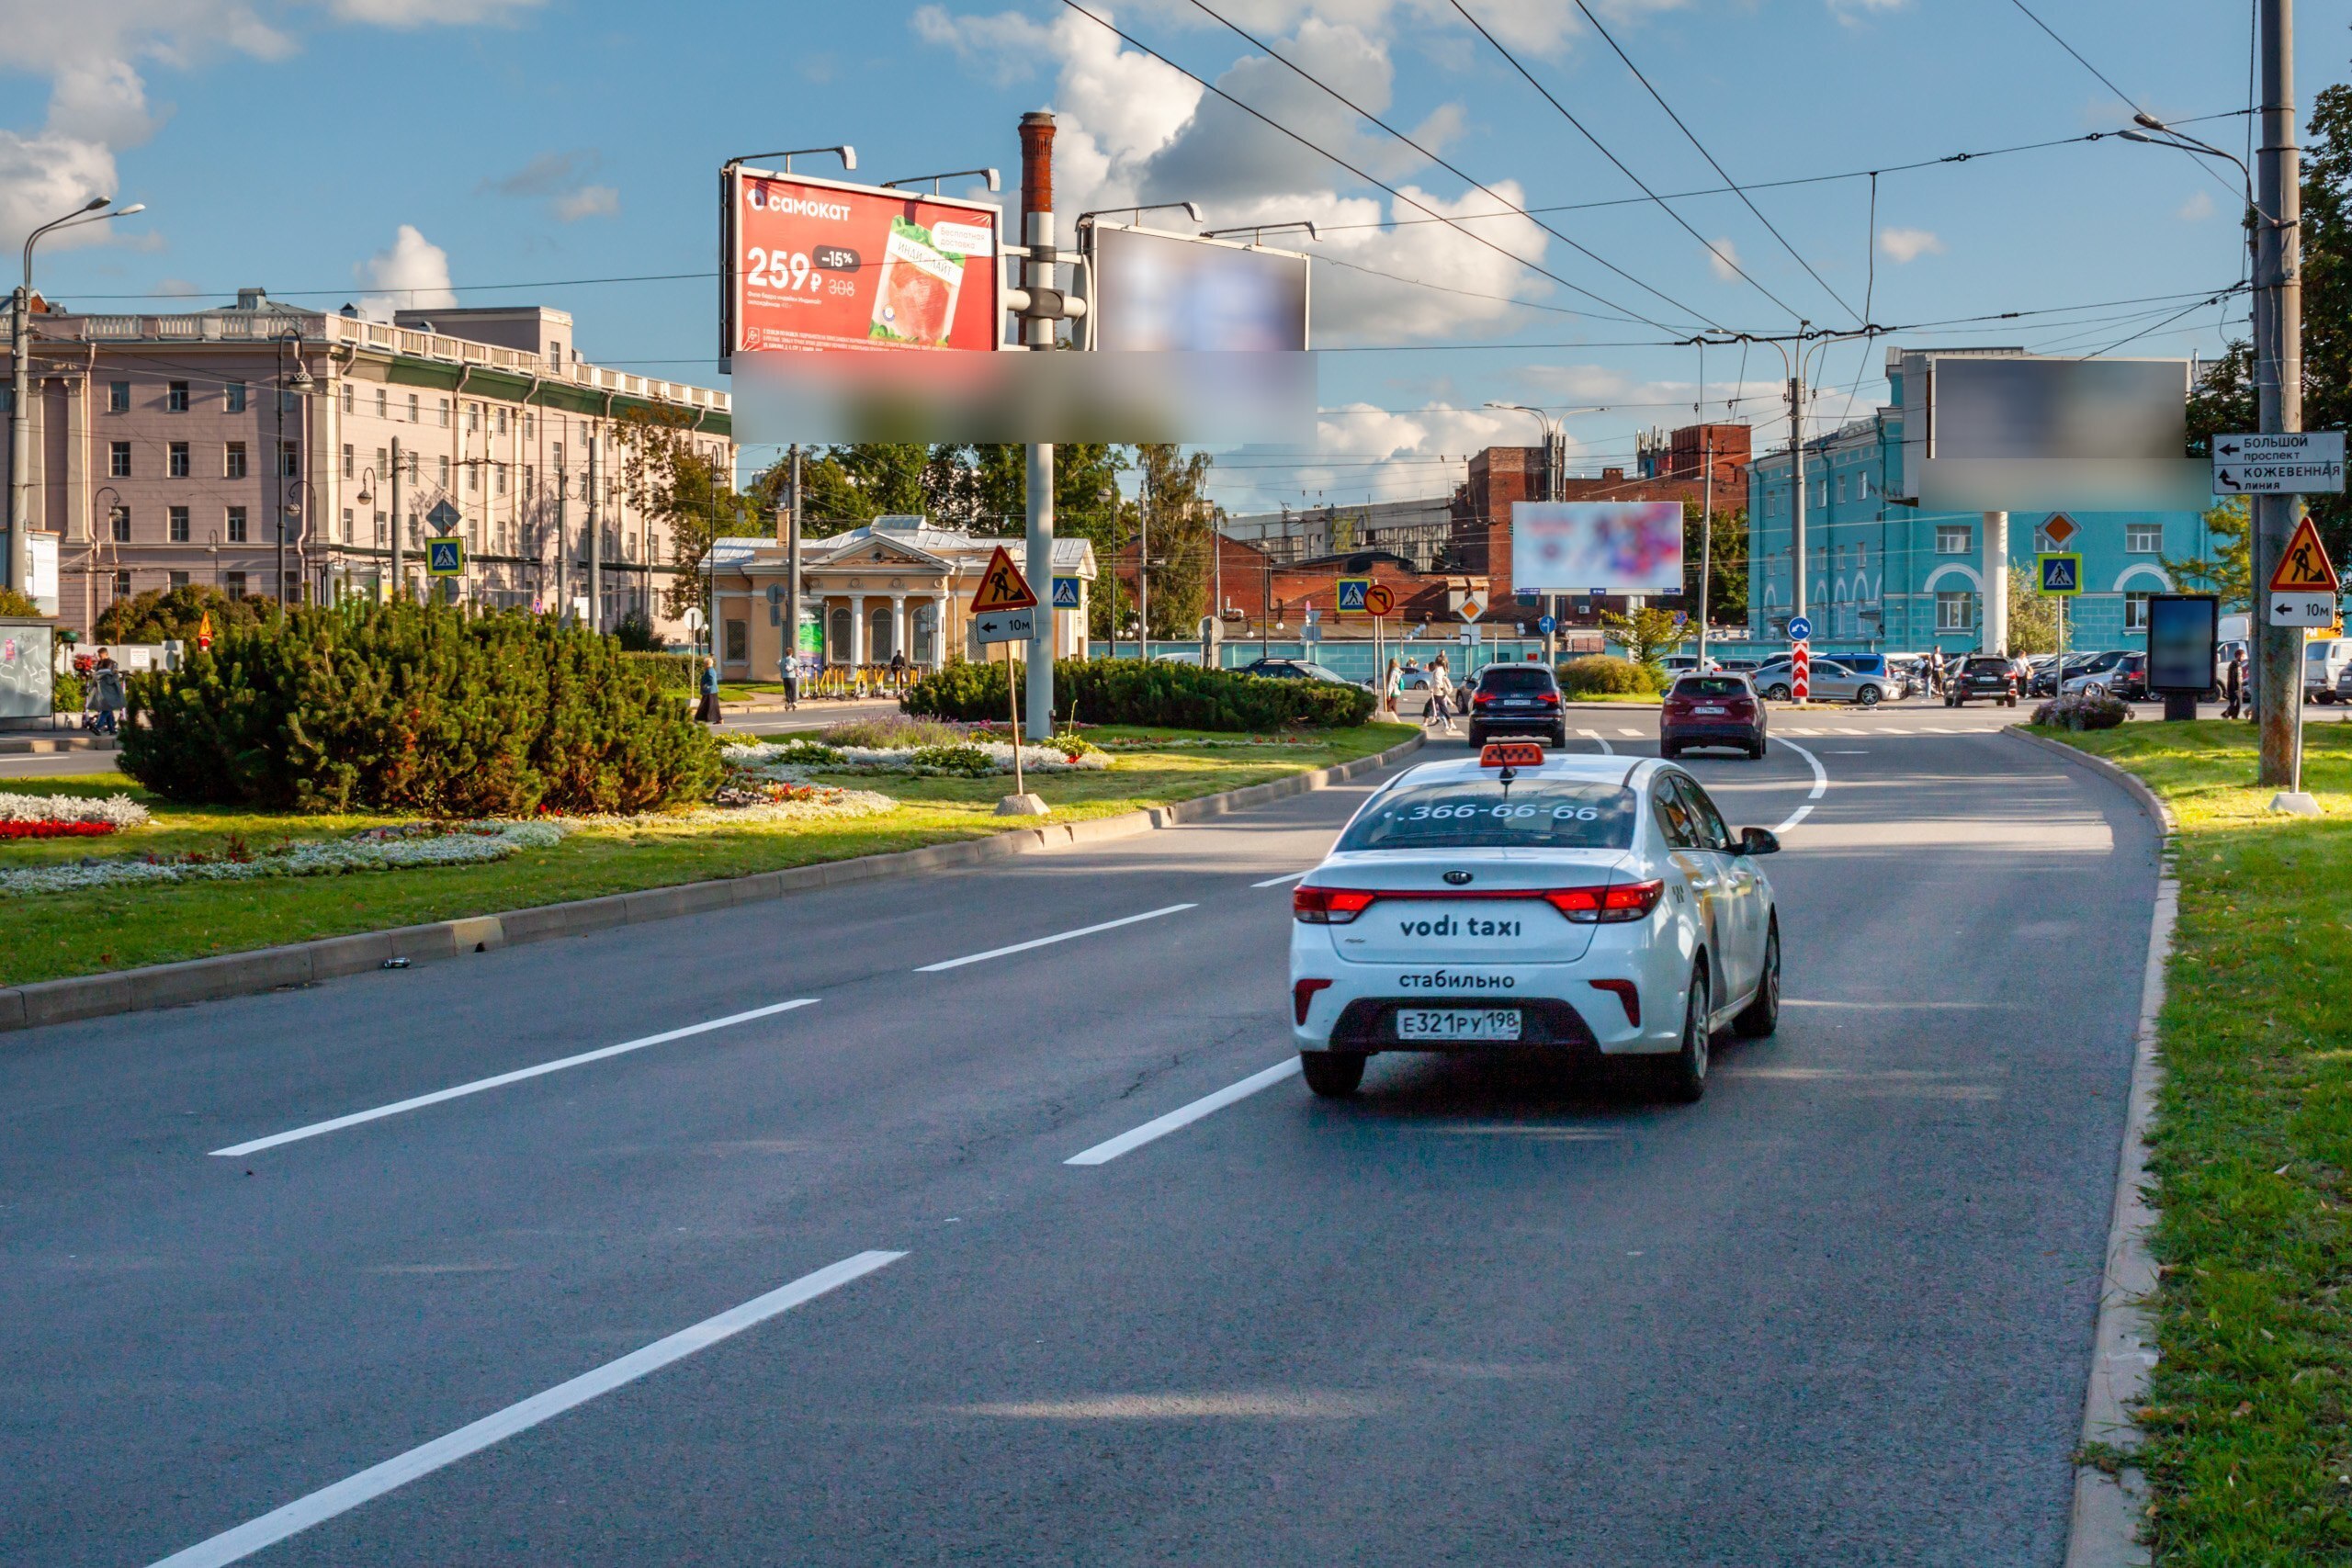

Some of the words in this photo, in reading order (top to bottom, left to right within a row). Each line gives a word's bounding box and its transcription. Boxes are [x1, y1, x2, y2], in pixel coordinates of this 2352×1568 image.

[769, 195, 851, 221] самокат
[940, 227, 985, 240] Бесплатная
[940, 239, 976, 250] доставка
[821, 251, 854, 267] -15%
[828, 278, 855, 297] 308
[2244, 434, 2308, 448] БОЛЬШОЙ
[2244, 452, 2300, 462] проспект
[2244, 466, 2340, 478] КОЖЕВЕННАЯ
[2244, 482, 2280, 491] линия
[1408, 804, 1599, 821] 366-66-66
[1399, 914, 1458, 936] vodi
[1467, 917, 1521, 936] taxi
[1399, 969, 1515, 988] стабильно
